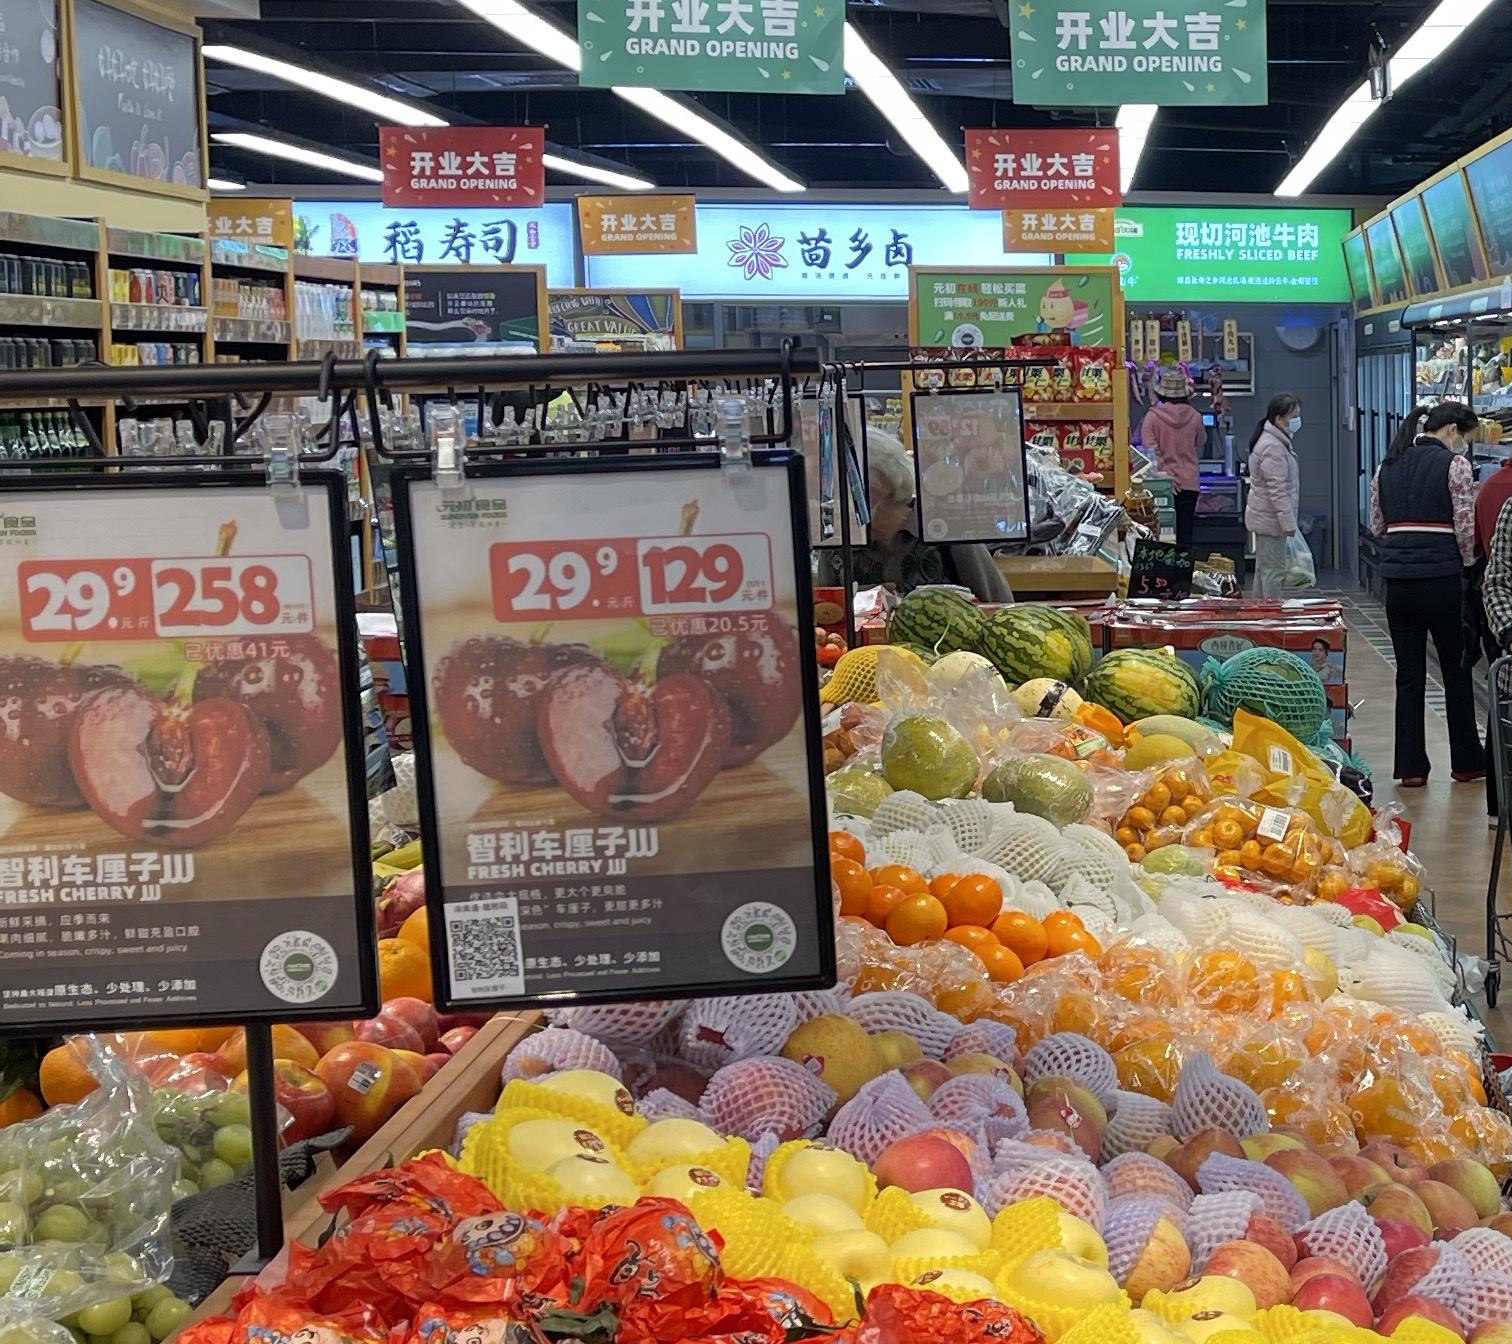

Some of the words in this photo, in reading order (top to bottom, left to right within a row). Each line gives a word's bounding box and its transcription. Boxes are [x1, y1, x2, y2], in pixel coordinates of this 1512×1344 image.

[1055, 10, 1222, 51] 开业大吉
[626, 37, 701, 57] GRAND
[706, 40, 799, 60] OPENING
[1056, 55, 1128, 73] GRAND
[1133, 55, 1222, 73] OPENING
[410, 151, 518, 177] 开业大吉
[993, 152, 1096, 177] 开业大吉
[410, 178, 457, 190] GRAND
[459, 178, 518, 190] OPENING
[993, 178, 1039, 191] GRAND
[1040, 178, 1096, 190] OPENING
[208, 216, 273, 234] 业大吉
[600, 212, 678, 232] 开业大吉
[1021, 214, 1096, 232] 开业大吉
[383, 216, 519, 265] 稻寿司
[601, 232, 634, 242] GRAND
[636, 232, 678, 242] OPENING
[1021, 231, 1054, 241] GRAND
[1055, 232, 1096, 242] OPENING
[1175, 222, 1319, 248] 现切河池牛肉
[1176, 248, 1234, 261] FRESHLY
[1239, 248, 1283, 261] SLICED
[1287, 248, 1319, 261] BEEF
[567, 320, 601, 333] GREAT
[642, 543, 745, 605] 129
[156, 564, 281, 627] 258
[651, 614, 769, 637] 已优惠20.5元
[184, 641, 291, 662] 已优惠41元
[467, 826, 659, 864] 智利车厘子JJJ
[0, 851, 195, 887] 智利车厘子JJJ
[468, 862, 526, 880] FRESH
[530, 859, 603, 877] CHERRY
[0, 888, 55, 904] FRESH
[60, 884, 137, 903] CHERRY
[613, 917, 630, 927] and
[117, 944, 145, 955] sweet
[146, 943, 165, 954] and
[165, 942, 188, 954] juicy
